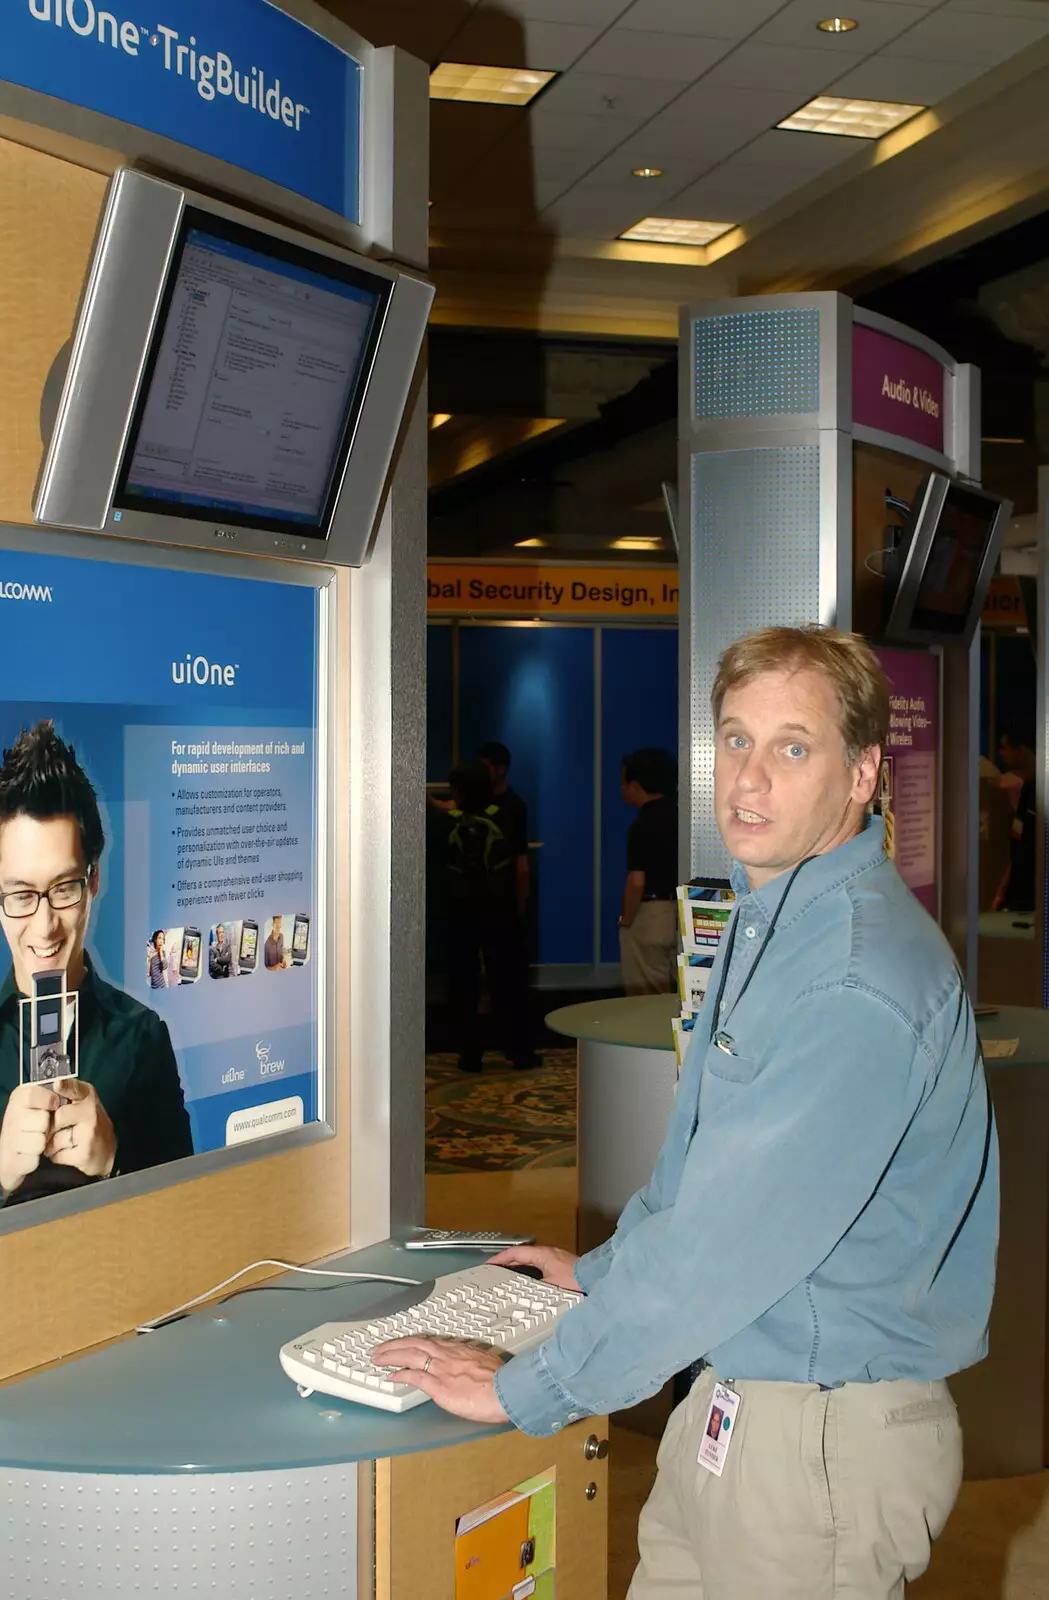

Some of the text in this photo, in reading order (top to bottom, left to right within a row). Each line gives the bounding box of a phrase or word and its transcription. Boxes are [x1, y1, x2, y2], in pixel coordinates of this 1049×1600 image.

[881, 374, 940, 418] Audio & Video
[469, 579, 564, 605] Security
[571, 581, 656, 606] Design,
[172, 741, 305, 758] For rapid development of rich and
[172, 760, 270, 777] dynamic user interfaces
[177, 788, 282, 799] Allows customization for operators,
[176, 802, 286, 816] manufacturers and content providers
[177, 822, 287, 837] Provides unmatched user choice and
[178, 836, 298, 855] personalization with over-the-air updates
[178, 854, 260, 870] of dynamic UIs and themes
[177, 870, 303, 891] Offers a comprehensive end-user shopping
[177, 889, 264, 908] experience with fewer clicks
[260, 1059, 285, 1075] brew
[233, 1107, 297, 1132] www.qualcomm.com
